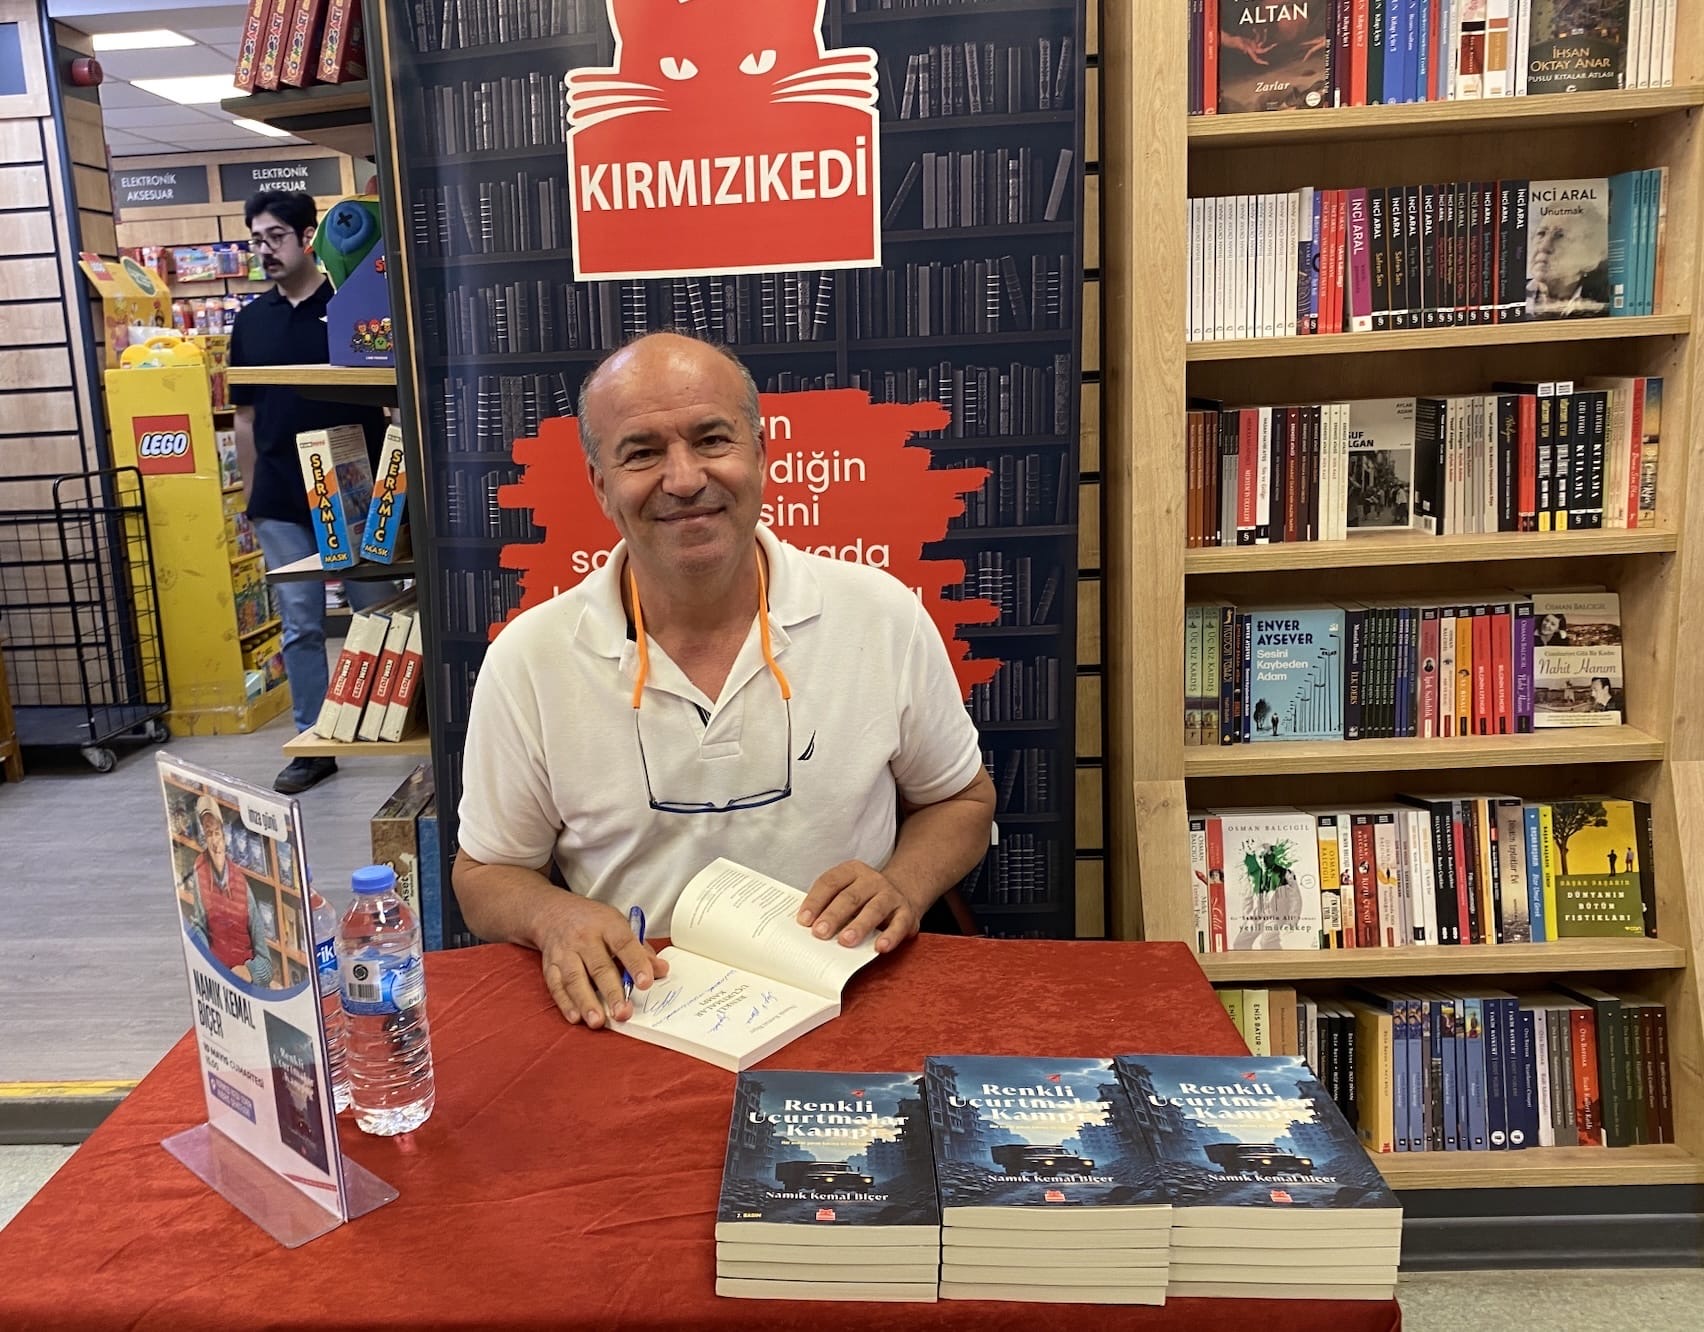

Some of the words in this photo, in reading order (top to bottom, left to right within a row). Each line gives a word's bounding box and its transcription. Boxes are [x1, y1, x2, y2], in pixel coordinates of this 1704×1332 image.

[1239, 3, 1308, 25] ALTAN
[1552, 46, 1590, 59] İHSAN
[1530, 60, 1570, 72] OKTAY
[1575, 58, 1611, 69] ANAR
[1528, 75, 1552, 83] PUSLU
[1255, 80, 1290, 93] Zarlar
[252, 164, 308, 179] ELEKTRONİK
[580, 137, 867, 212] KIRMIZIKEDİ
[121, 173, 176, 188] ELEKTRONİK
[259, 181, 306, 192] AKSESUAR
[127, 189, 174, 201] AKSESUAR
[1532, 188, 1556, 202] NCİ
[1560, 189, 1597, 201] ARAL
[1352, 198, 1365, 222] İNCİ
[1501, 206, 1509, 223] ARAL
[1540, 206, 1584, 216] Unutmak
[1424, 214, 1433, 235] ARAL
[1457, 209, 1465, 228] ARAL
[1470, 208, 1478, 227] ARAL
[1516, 208, 1526, 229] ARAL
[1373, 218, 1382, 239] ARAL
[1392, 216, 1401, 238] ARAL
[1408, 215, 1417, 236] ARAL
[1352, 224, 1365, 255] ARAL
[1348, 431, 1364, 439] SUF
[140, 431, 190, 457] LEGO
[770, 451, 866, 493] diğin
[310, 453, 339, 549] SERAMIC
[374, 449, 403, 542] SERAMIC
[364, 544, 388, 557] MASK
[325, 553, 347, 563] MASK
[1257, 620, 1300, 631] ENVER
[1257, 633, 1313, 645] AYSEVER
[1189, 646, 1198, 660] KIZ
[1206, 646, 1215, 660] KIZ
[1256, 649, 1288, 659] Sesini
[1256, 659, 1308, 670] Kaybeden
[1539, 658, 1570, 674] Nahit
[1574, 658, 1616, 675] Hanım
[1256, 672, 1287, 681] Adam
[1350, 685, 1359, 704] DERS
[1239, 923, 1261, 933] yeşil
[1265, 923, 1312, 932] mürekkep
[193, 969, 223, 1011] NAMIK
[223, 985, 255, 1030] KEMAL
[1253, 1004, 1261, 1021] ENİS
[1253, 1023, 1261, 1046] BATUR
[1508, 1029, 1516, 1054] BAYKURT
[1489, 1030, 1497, 1055] BAYKURT
[982, 1084, 1074, 1097] Renkli
[1179, 1083, 1274, 1095] Renkli
[785, 1100, 873, 1113] Renkli
[949, 1096, 1113, 1110] Uçurtmalar
[1149, 1095, 1315, 1108] Uçurtmalar
[749, 1112, 909, 1126] Uçurtmalar
[1034, 1175, 1075, 1183] Kemal
[1208, 1174, 1252, 1183] Namık
[1255, 1174, 1297, 1183] Kemal
[765, 1191, 807, 1200] Namık
[810, 1191, 850, 1200] Kemal
